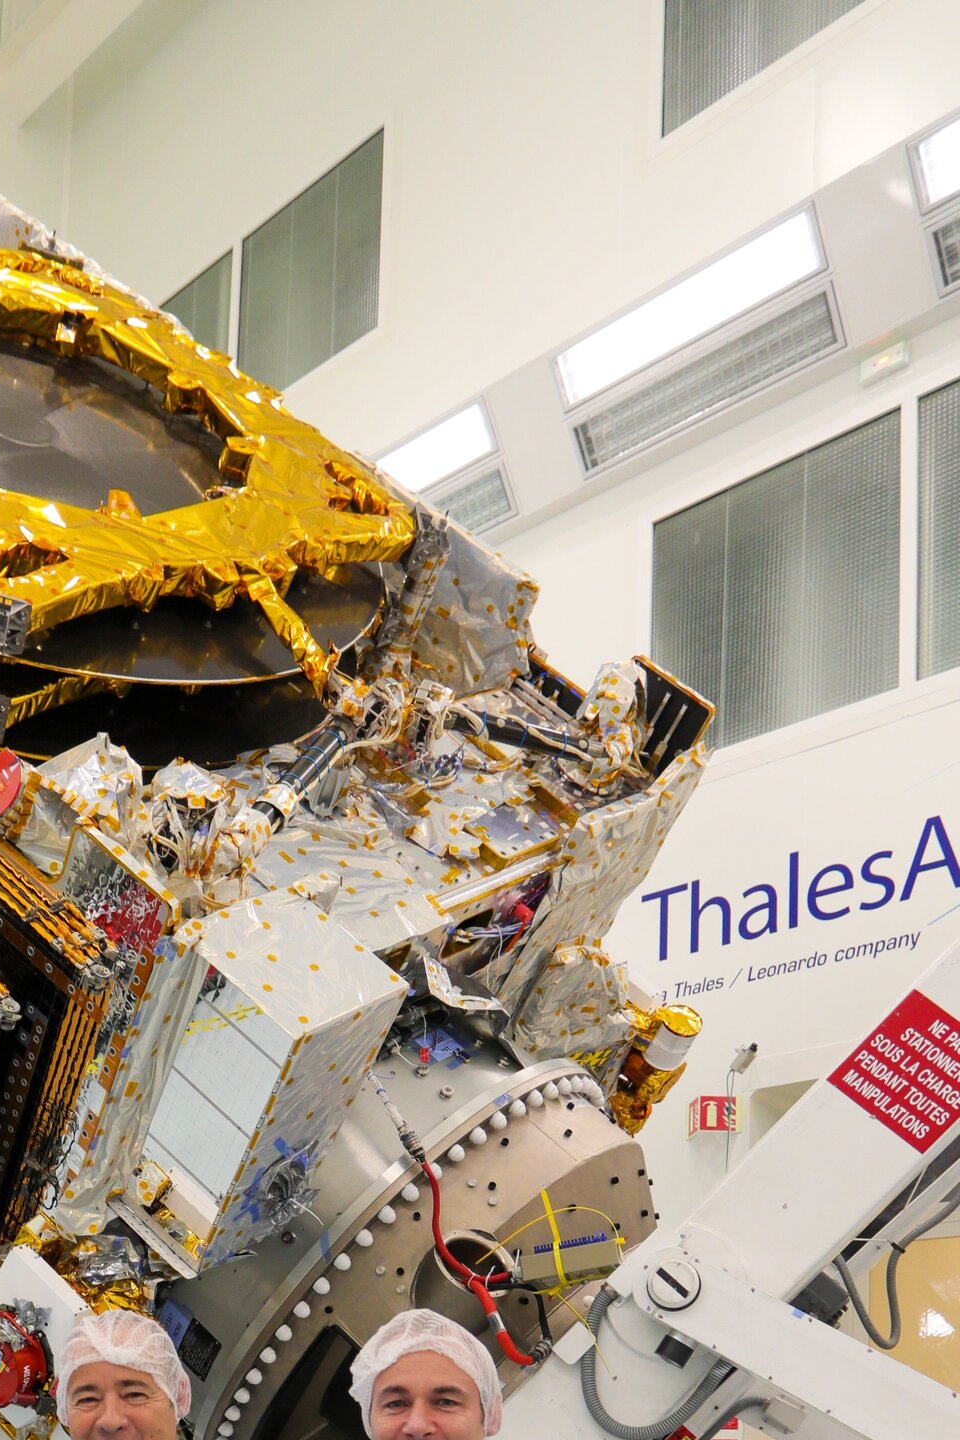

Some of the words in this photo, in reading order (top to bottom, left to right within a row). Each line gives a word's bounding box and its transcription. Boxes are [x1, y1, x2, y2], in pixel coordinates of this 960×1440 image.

[674, 976, 725, 999] Thales
[747, 951, 828, 983] Leonardo
[834, 931, 922, 963] company
[870, 1033, 905, 1063] SOUS
[899, 1055, 921, 1076] LA
[927, 1019, 950, 1040] NE
[943, 1031, 960, 1056] PA
[854, 1050, 909, 1093] PENDANT
[842, 1069, 930, 1139] MANIPULATIONS
[904, 1086, 950, 1126] TOUTES
